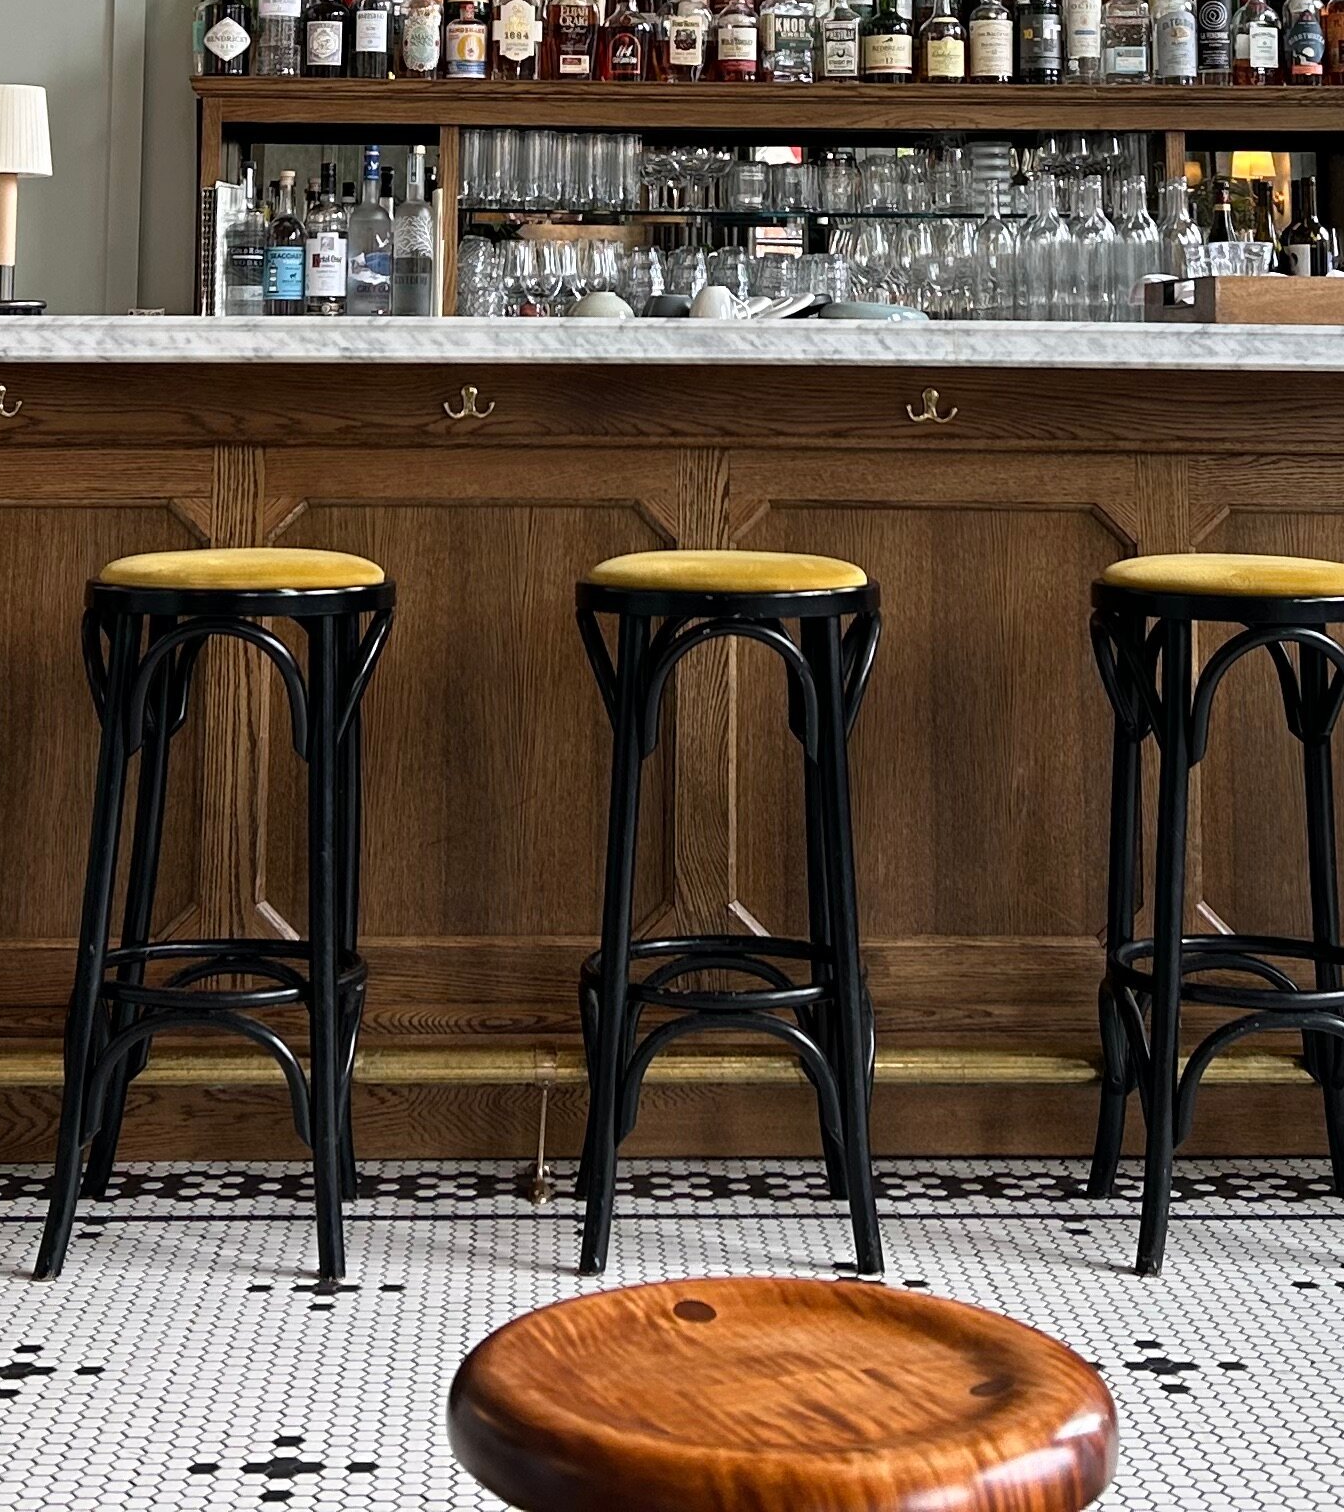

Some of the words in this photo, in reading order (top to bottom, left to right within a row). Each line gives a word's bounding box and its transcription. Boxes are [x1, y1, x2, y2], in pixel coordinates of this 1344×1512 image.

[560, 6, 588, 17] ELIJAH
[559, 15, 588, 27] CRAIG
[775, 17, 806, 32] KNOB
